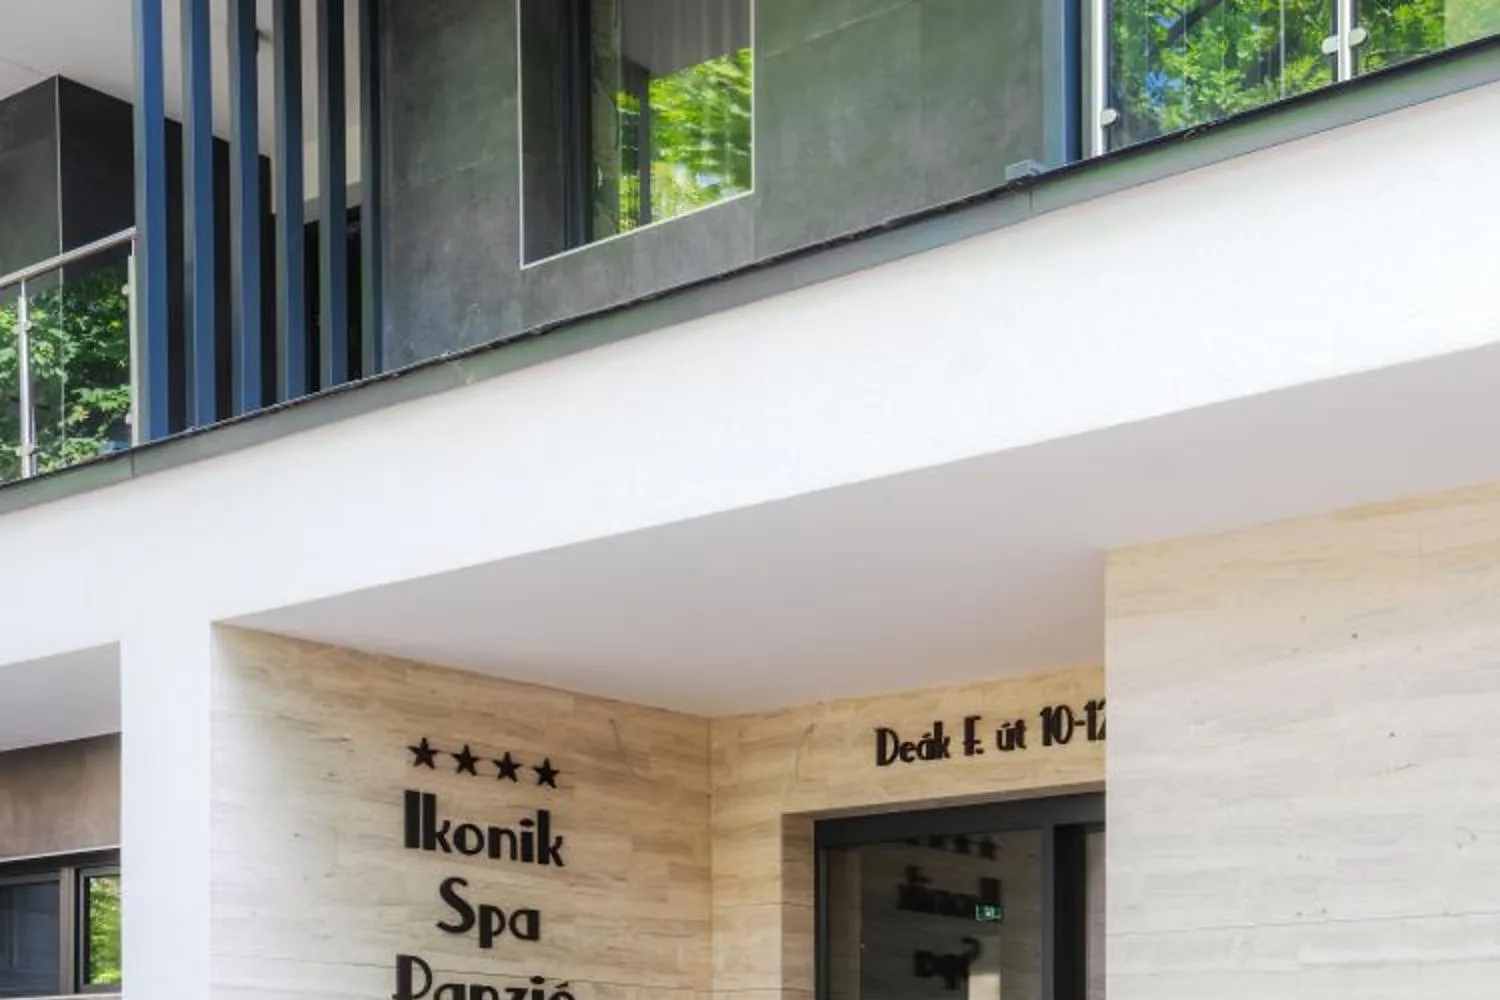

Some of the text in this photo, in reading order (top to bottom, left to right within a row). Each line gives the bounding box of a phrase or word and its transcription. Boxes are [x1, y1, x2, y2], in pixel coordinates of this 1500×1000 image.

[875, 720, 951, 766] Deák
[963, 715, 984, 756] F.
[996, 719, 1027, 750] út
[404, 789, 565, 867] Ikonik
[436, 877, 540, 948] Spa
